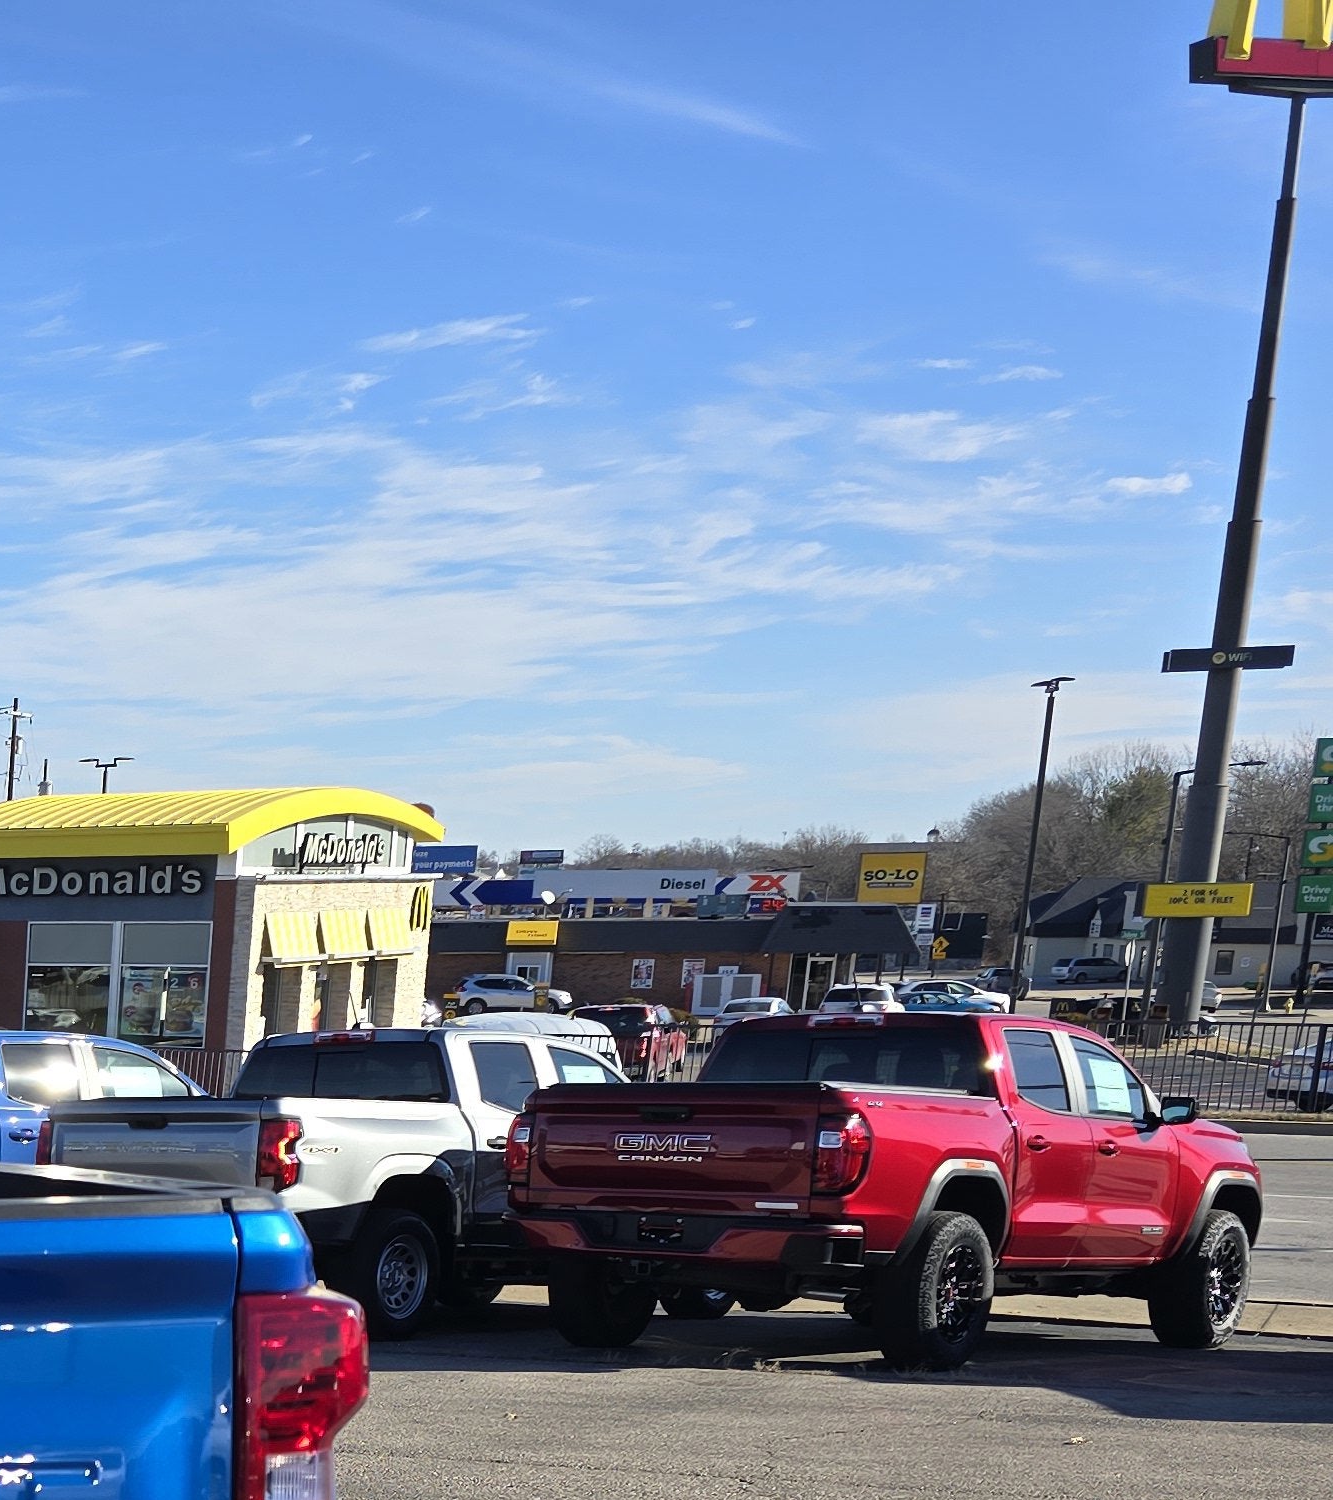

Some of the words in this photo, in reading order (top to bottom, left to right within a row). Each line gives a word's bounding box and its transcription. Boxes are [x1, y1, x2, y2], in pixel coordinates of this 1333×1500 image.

[1315, 794, 1333, 803] Dri
[864, 869, 919, 881] SO-LO
[660, 878, 706, 890] Diesel
[747, 874, 787, 891] ZX
[1302, 885, 1331, 894] Drive
[1211, 896, 1235, 904] FILET
[1304, 894, 1327, 903] thru
[614, 1133, 712, 1152] GMC
[617, 1154, 703, 1163] CANYON
